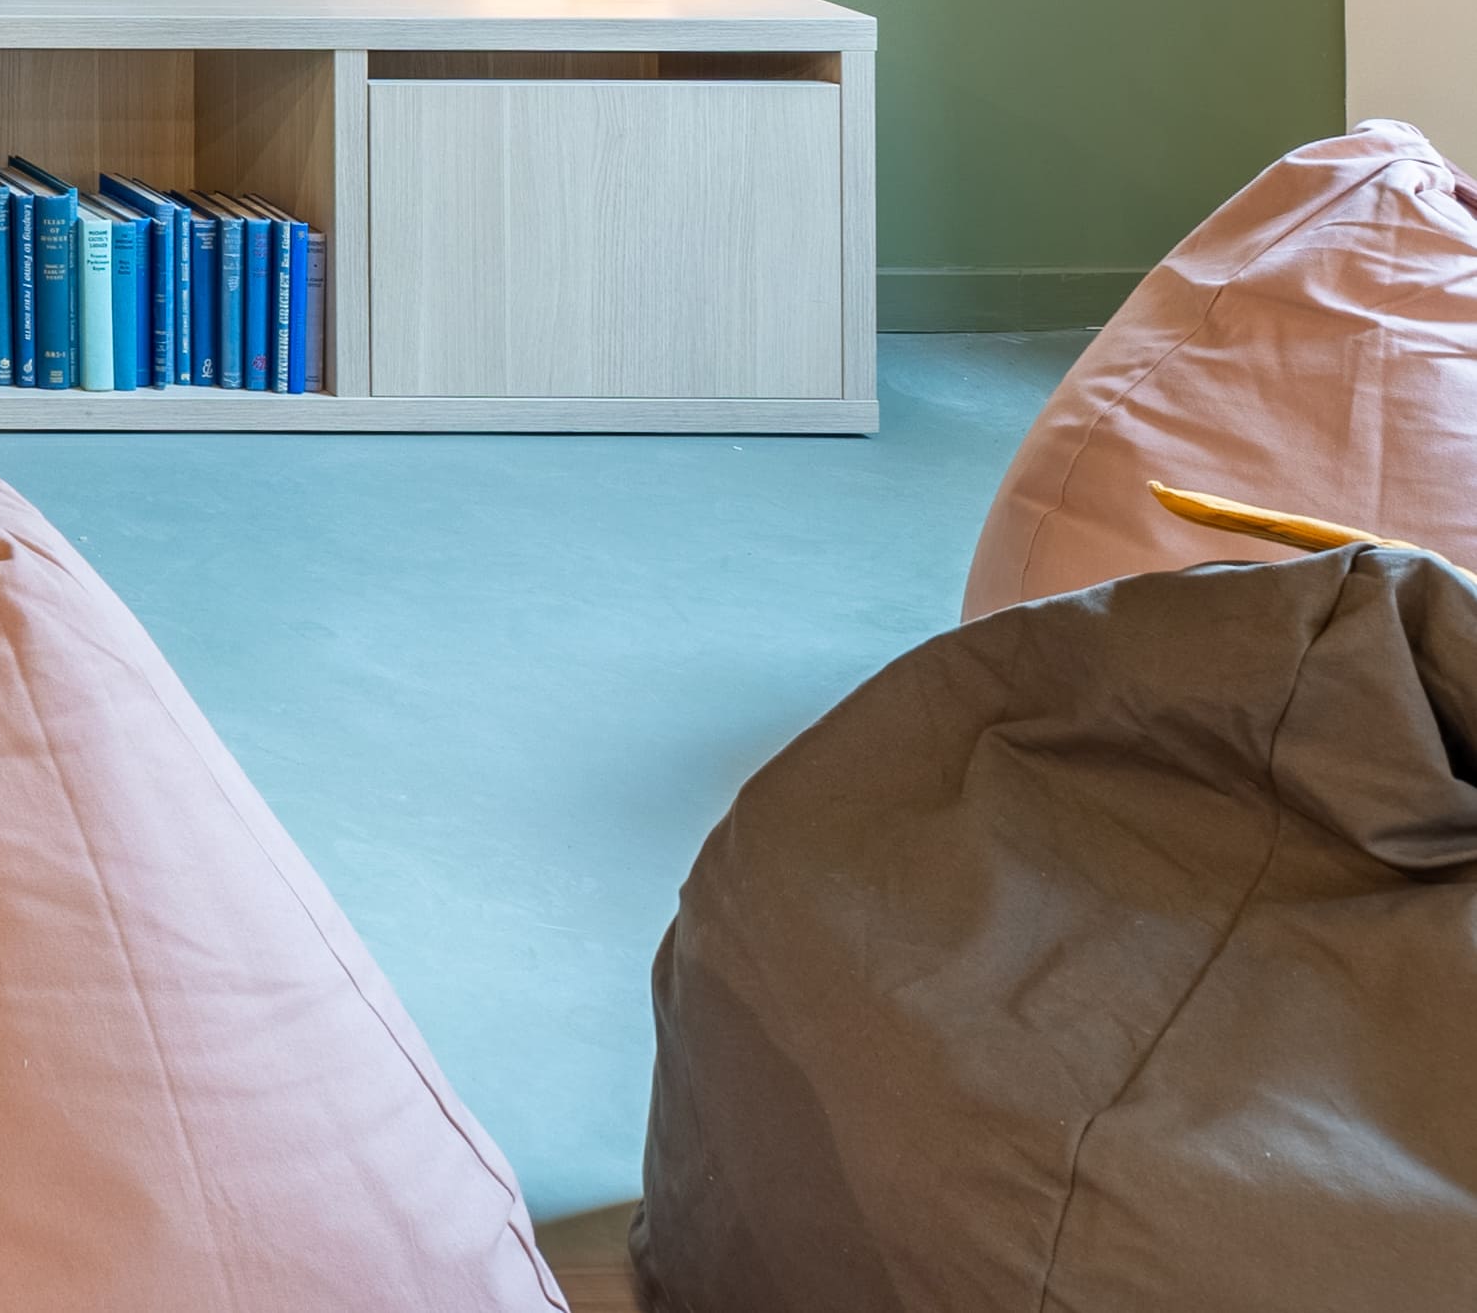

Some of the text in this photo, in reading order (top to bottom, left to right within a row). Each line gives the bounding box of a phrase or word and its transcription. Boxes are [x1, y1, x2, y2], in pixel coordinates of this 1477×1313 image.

[22, 204, 32, 282] Leaping to Fame
[279, 272, 289, 325] CRICKET
[277, 328, 289, 392] WATCHING
